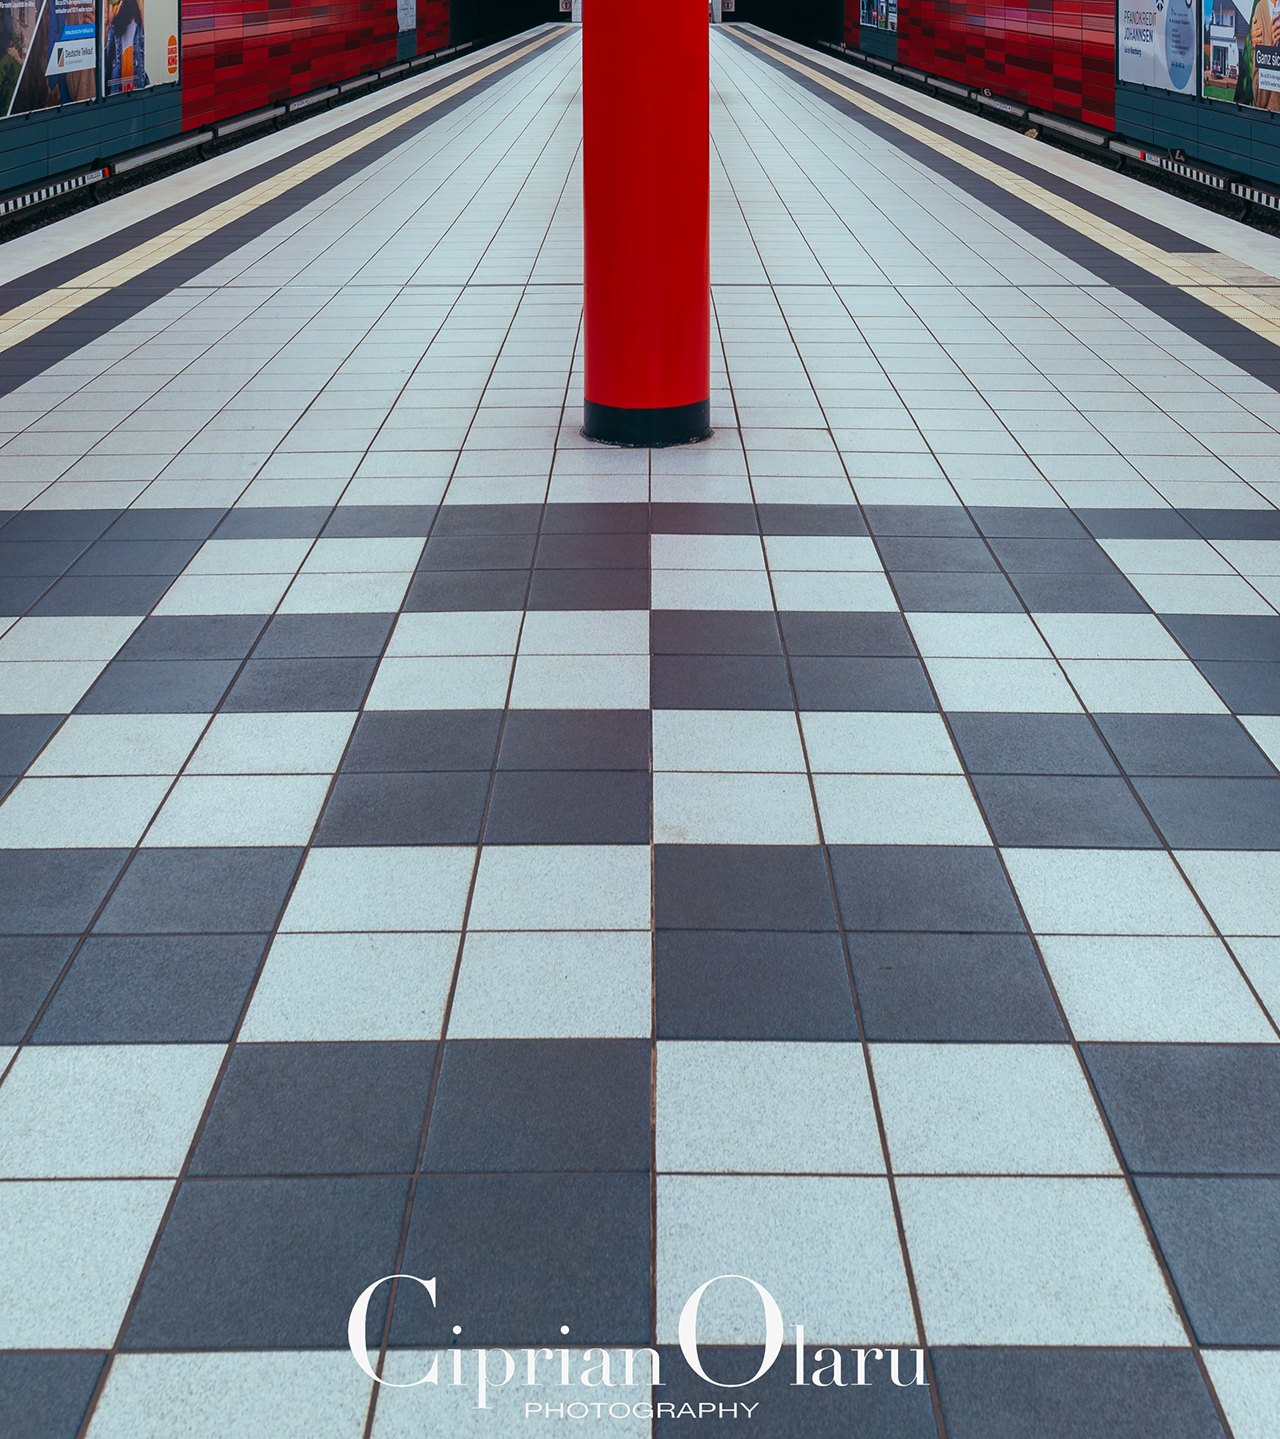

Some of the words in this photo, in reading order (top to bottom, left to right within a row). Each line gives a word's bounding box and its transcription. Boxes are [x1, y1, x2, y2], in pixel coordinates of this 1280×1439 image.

[1123, 10, 1157, 26] PFANDKREDIT
[1123, 27, 1154, 43] JOHANNSEN
[1256, 49, 1271, 65] Ganz
[983, 88, 992, 97] 6
[1175, 149, 1185, 161] 4
